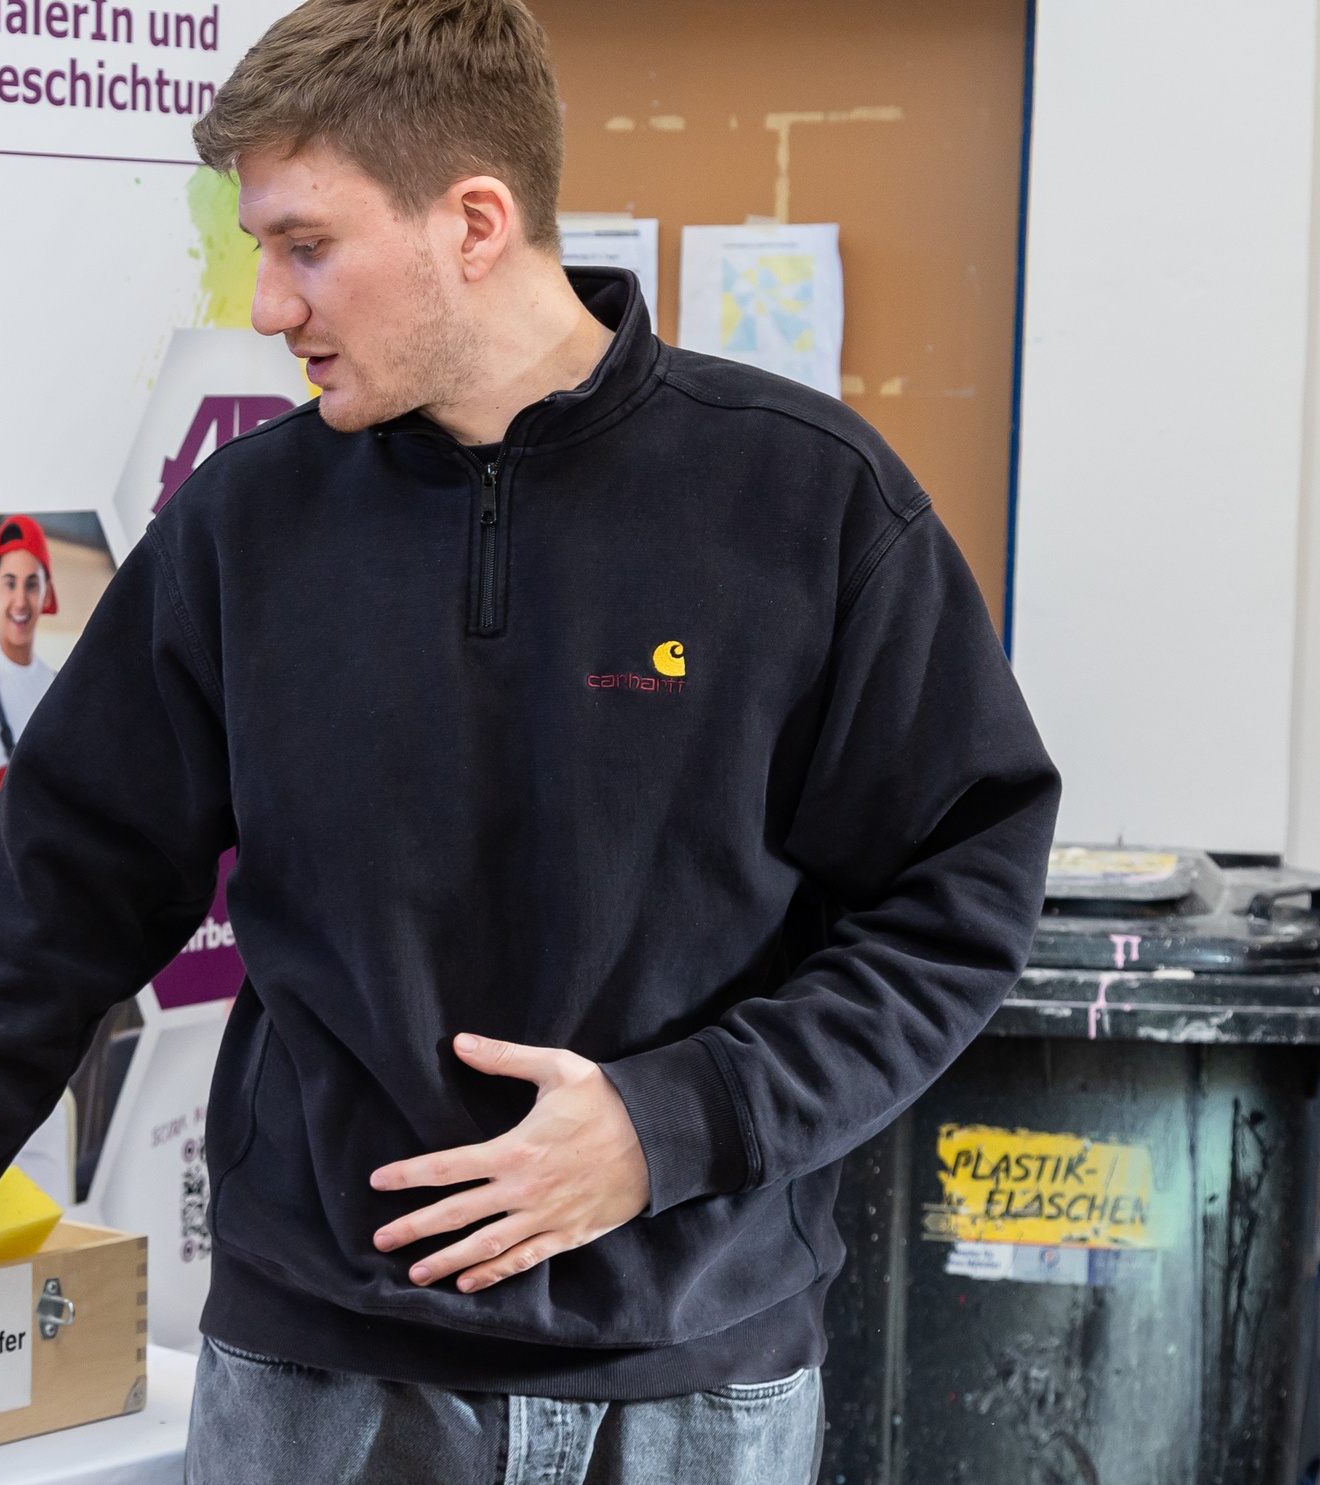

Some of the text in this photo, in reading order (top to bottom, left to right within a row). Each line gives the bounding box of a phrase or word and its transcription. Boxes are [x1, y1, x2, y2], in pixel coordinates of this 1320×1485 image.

[149, 4, 219, 51] und
[587, 673, 686, 694] carhartt
[951, 1147, 1097, 1185] PLASTIK-
